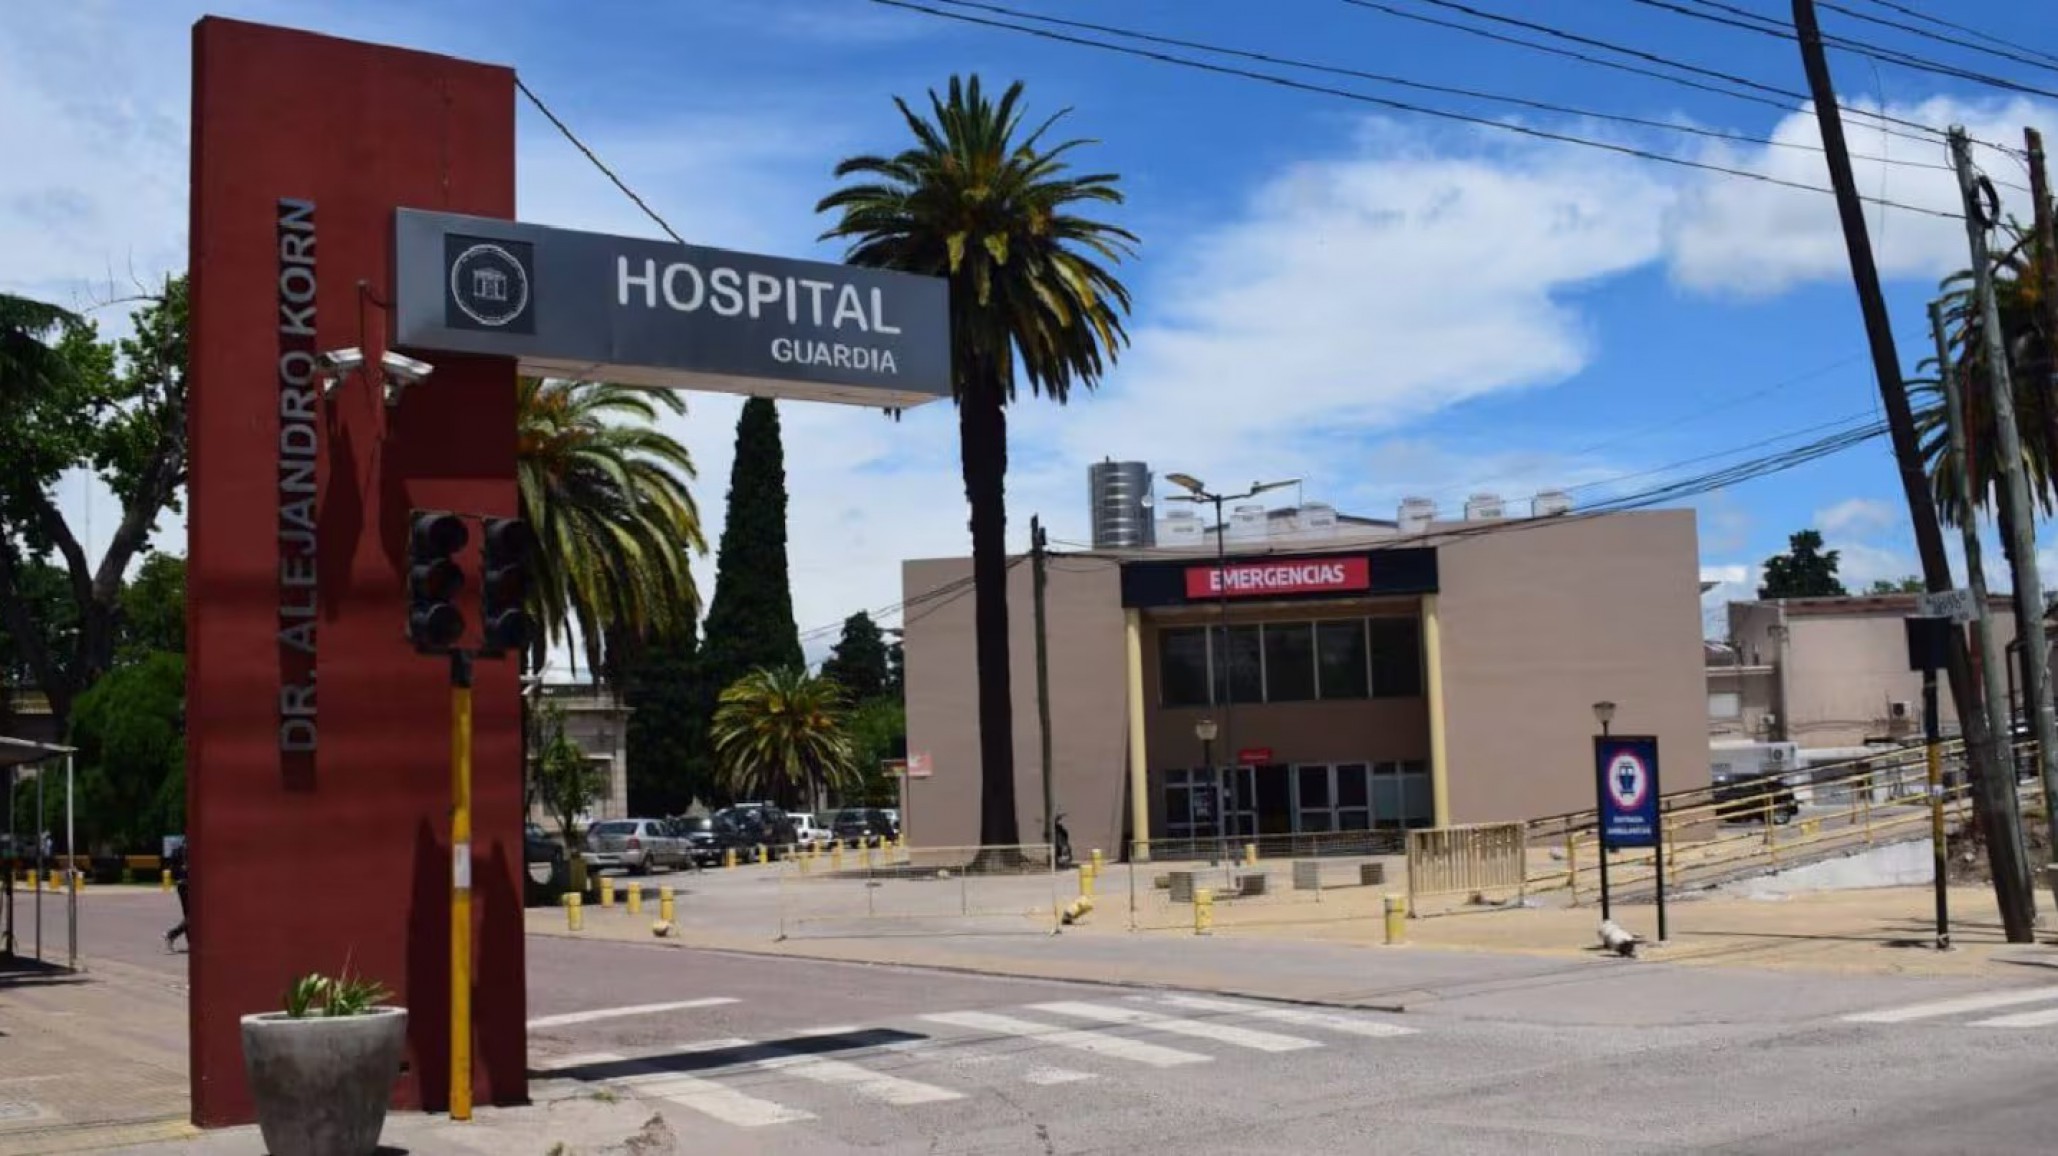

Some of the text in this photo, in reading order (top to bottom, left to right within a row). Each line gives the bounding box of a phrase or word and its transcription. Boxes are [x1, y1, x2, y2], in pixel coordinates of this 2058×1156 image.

[617, 255, 901, 334] HOSPITAL
[771, 338, 897, 374] GUARDIA
[279, 197, 317, 751] DR. ALEJANDRO KORN
[1209, 564, 1345, 591] EMERGENCIAS
